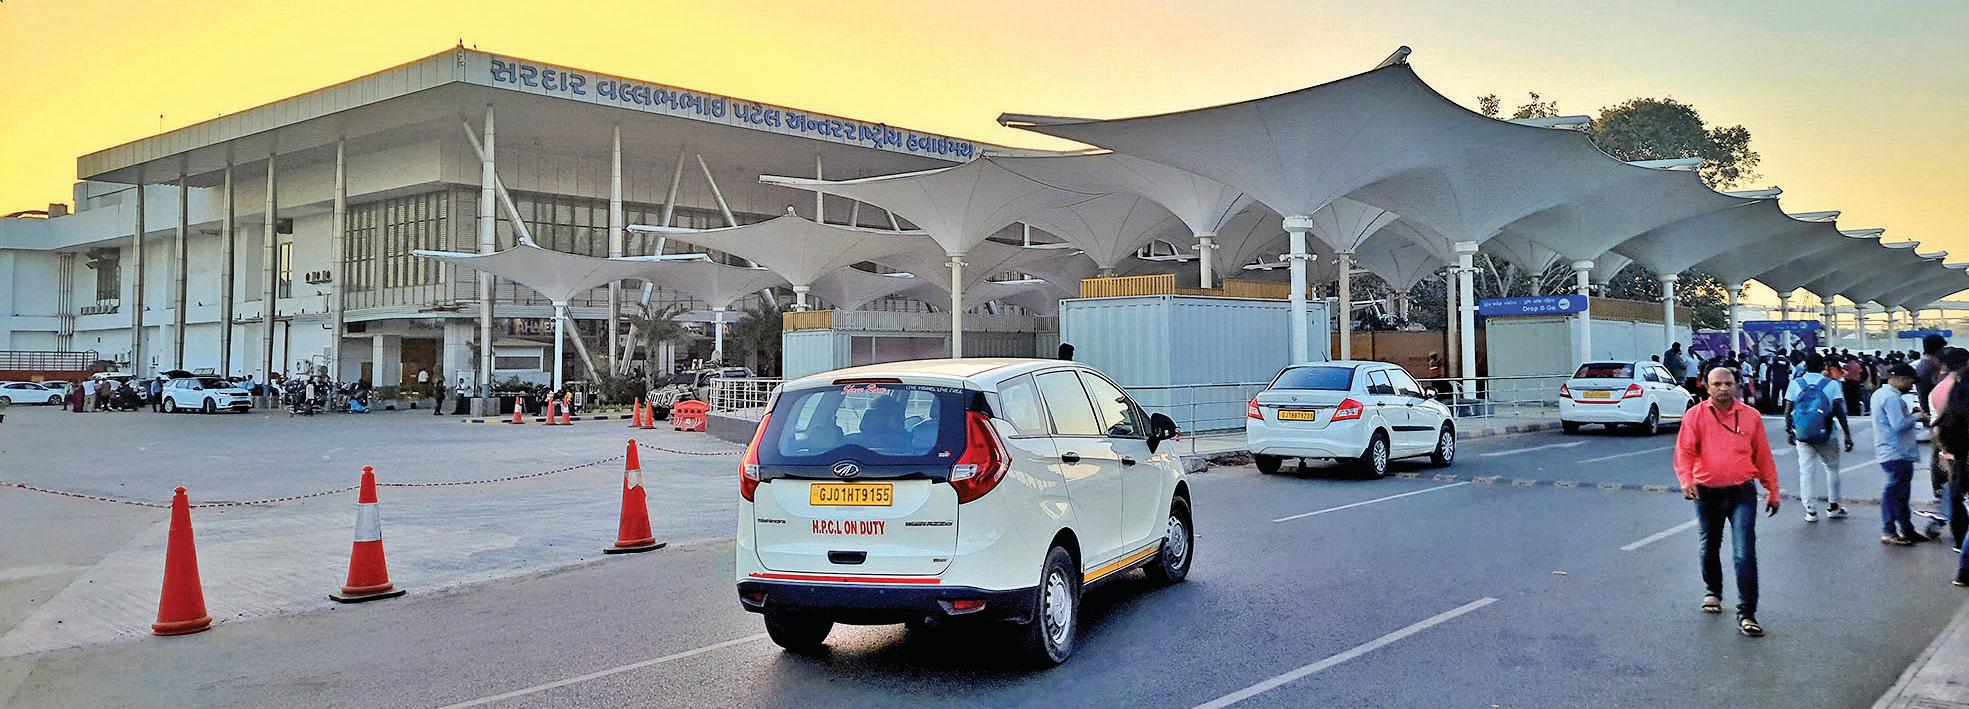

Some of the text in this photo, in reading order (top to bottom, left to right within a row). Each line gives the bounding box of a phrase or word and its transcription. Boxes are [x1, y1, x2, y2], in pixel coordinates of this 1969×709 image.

[490, 60, 587, 95] સરદાર
[906, 133, 976, 160] હવાઇમથ
[1522, 305, 1539, 313] Drop
[819, 487, 890, 502] GJ01HT9155
[844, 520, 858, 535] ON
[860, 521, 885, 536] DUTY
